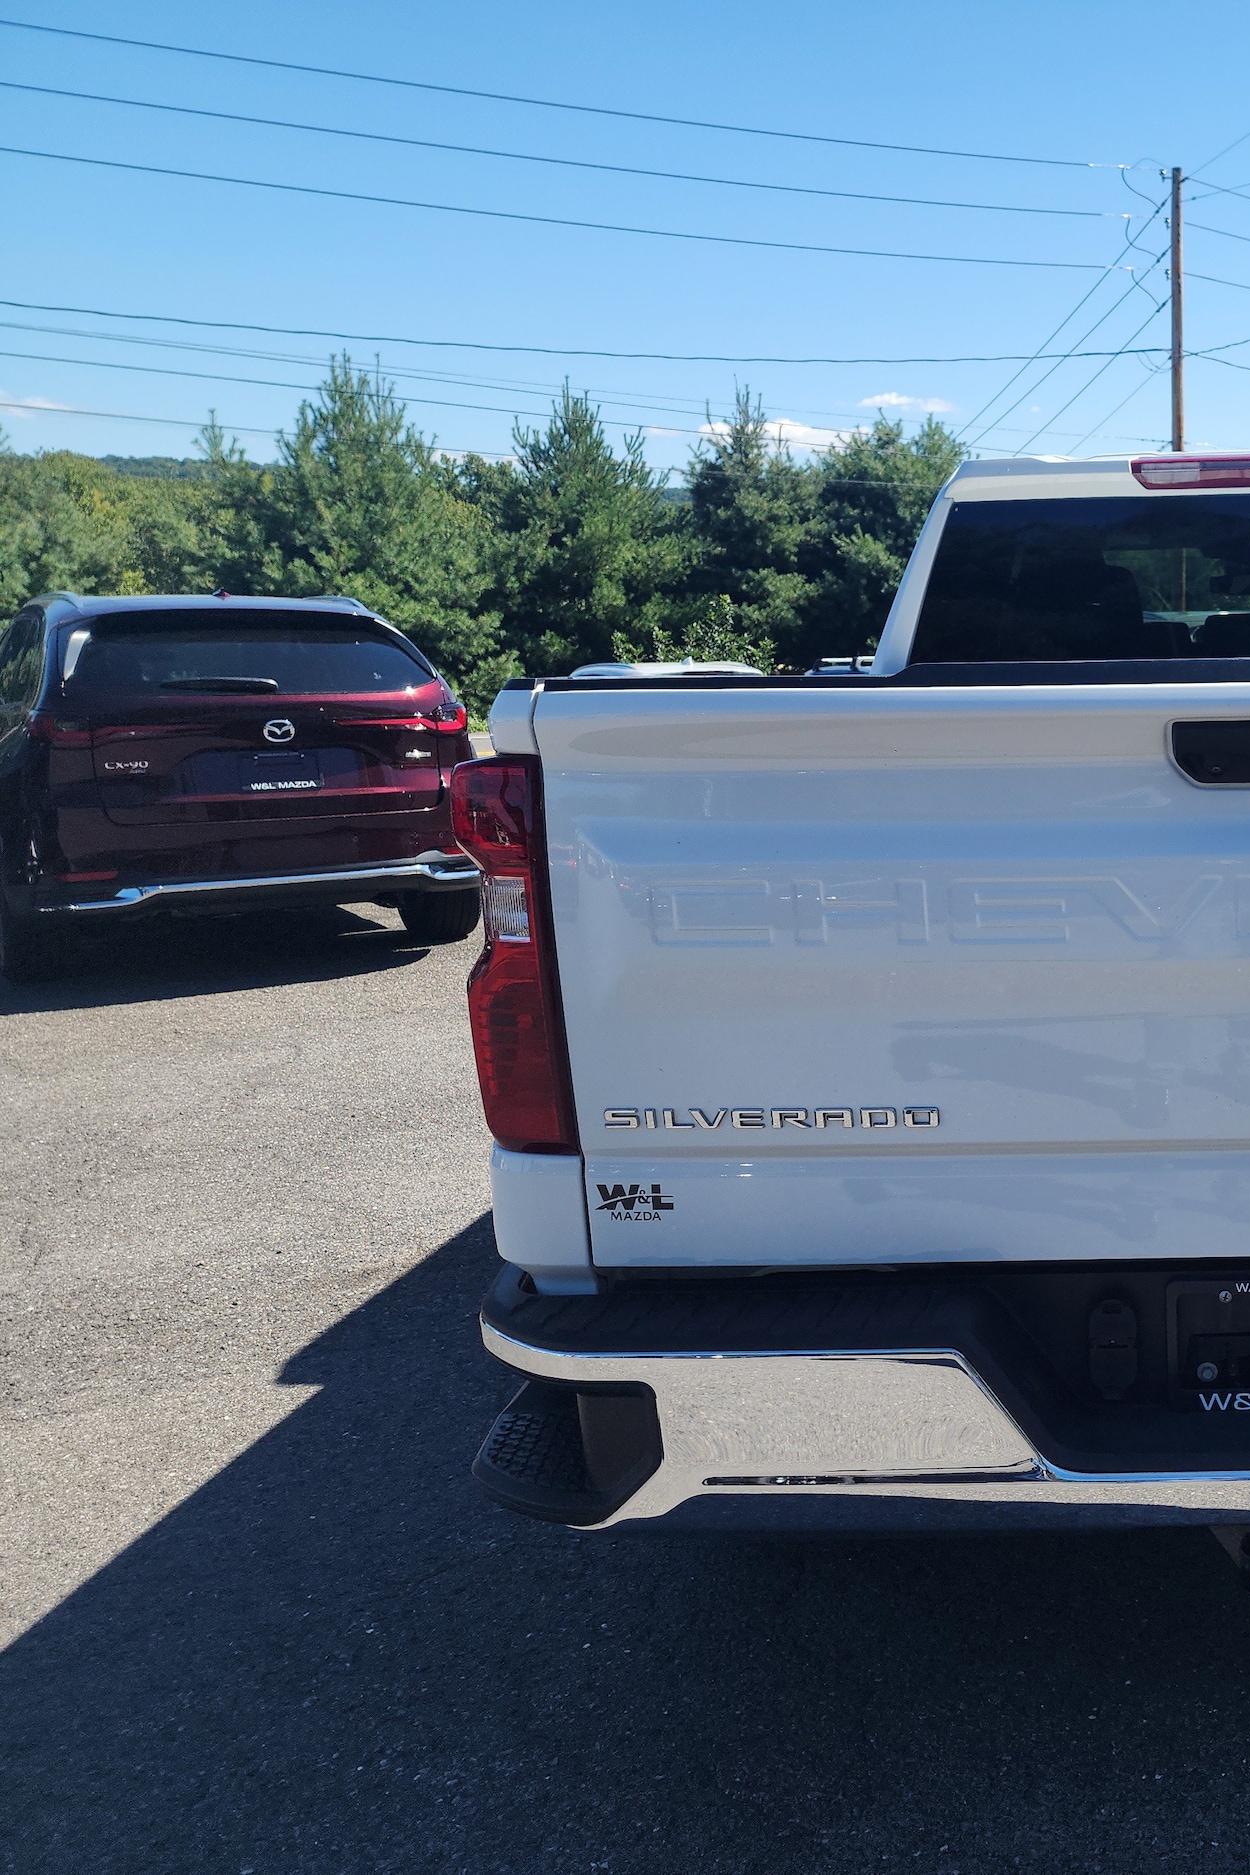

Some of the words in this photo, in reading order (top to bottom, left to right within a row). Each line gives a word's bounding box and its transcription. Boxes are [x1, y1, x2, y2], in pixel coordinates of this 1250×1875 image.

[104, 760, 149, 770] CX-90
[250, 782, 276, 791] W&L
[278, 780, 317, 789] MAZDA
[603, 1106, 941, 1130] SILVERADO
[595, 1184, 675, 1211] W&L
[610, 1211, 662, 1222] MAZDA
